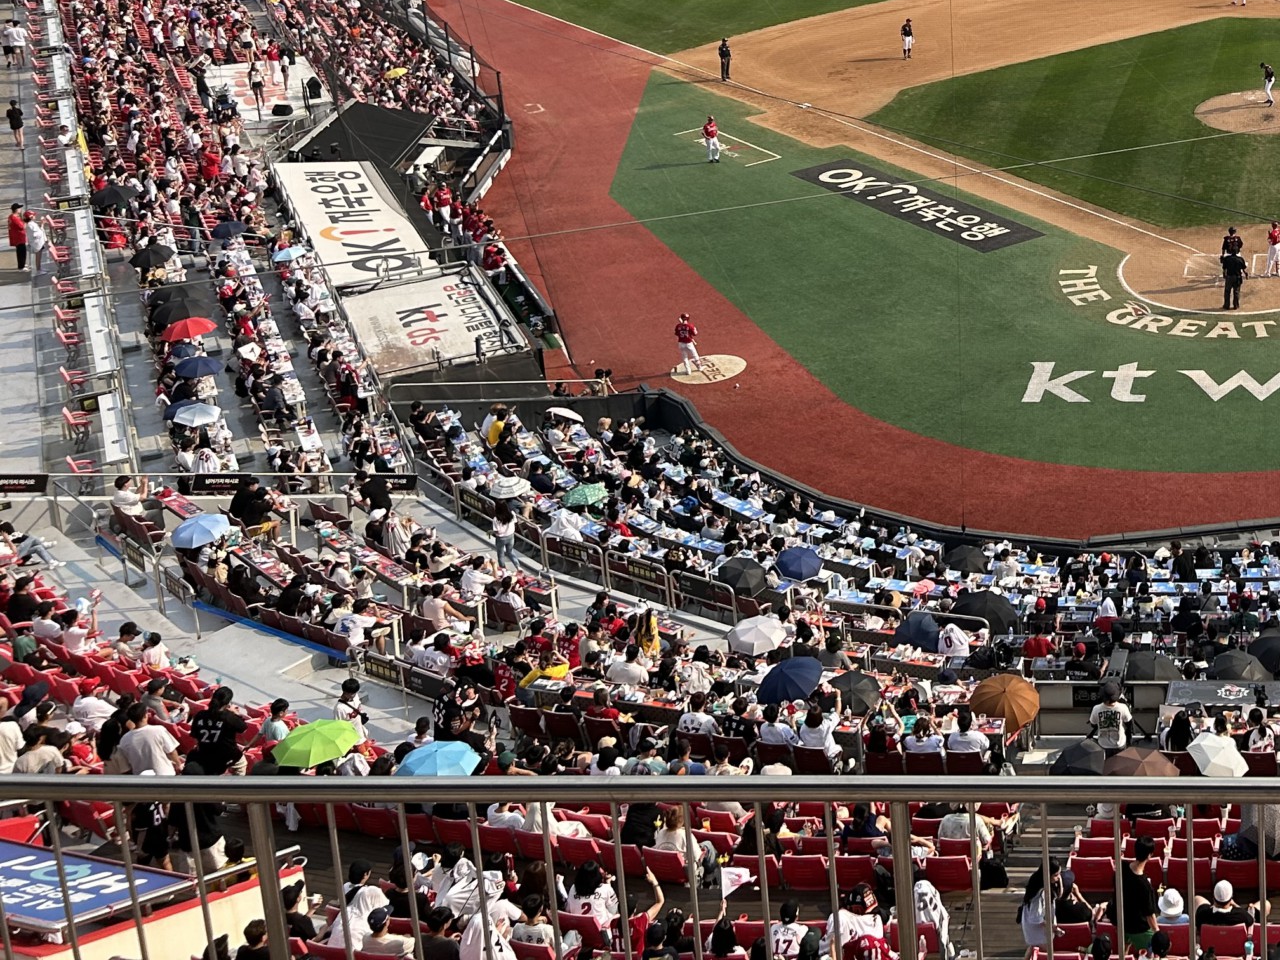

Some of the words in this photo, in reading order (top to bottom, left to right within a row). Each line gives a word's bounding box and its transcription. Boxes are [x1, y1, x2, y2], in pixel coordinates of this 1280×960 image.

[1058, 265, 1113, 307] THE
[1106, 304, 1278, 339] GREAT
[395, 303, 449, 328] kt
[406, 328, 449, 346] ds
[1021, 361, 1157, 403] kt
[775, 939, 793, 955] 17
